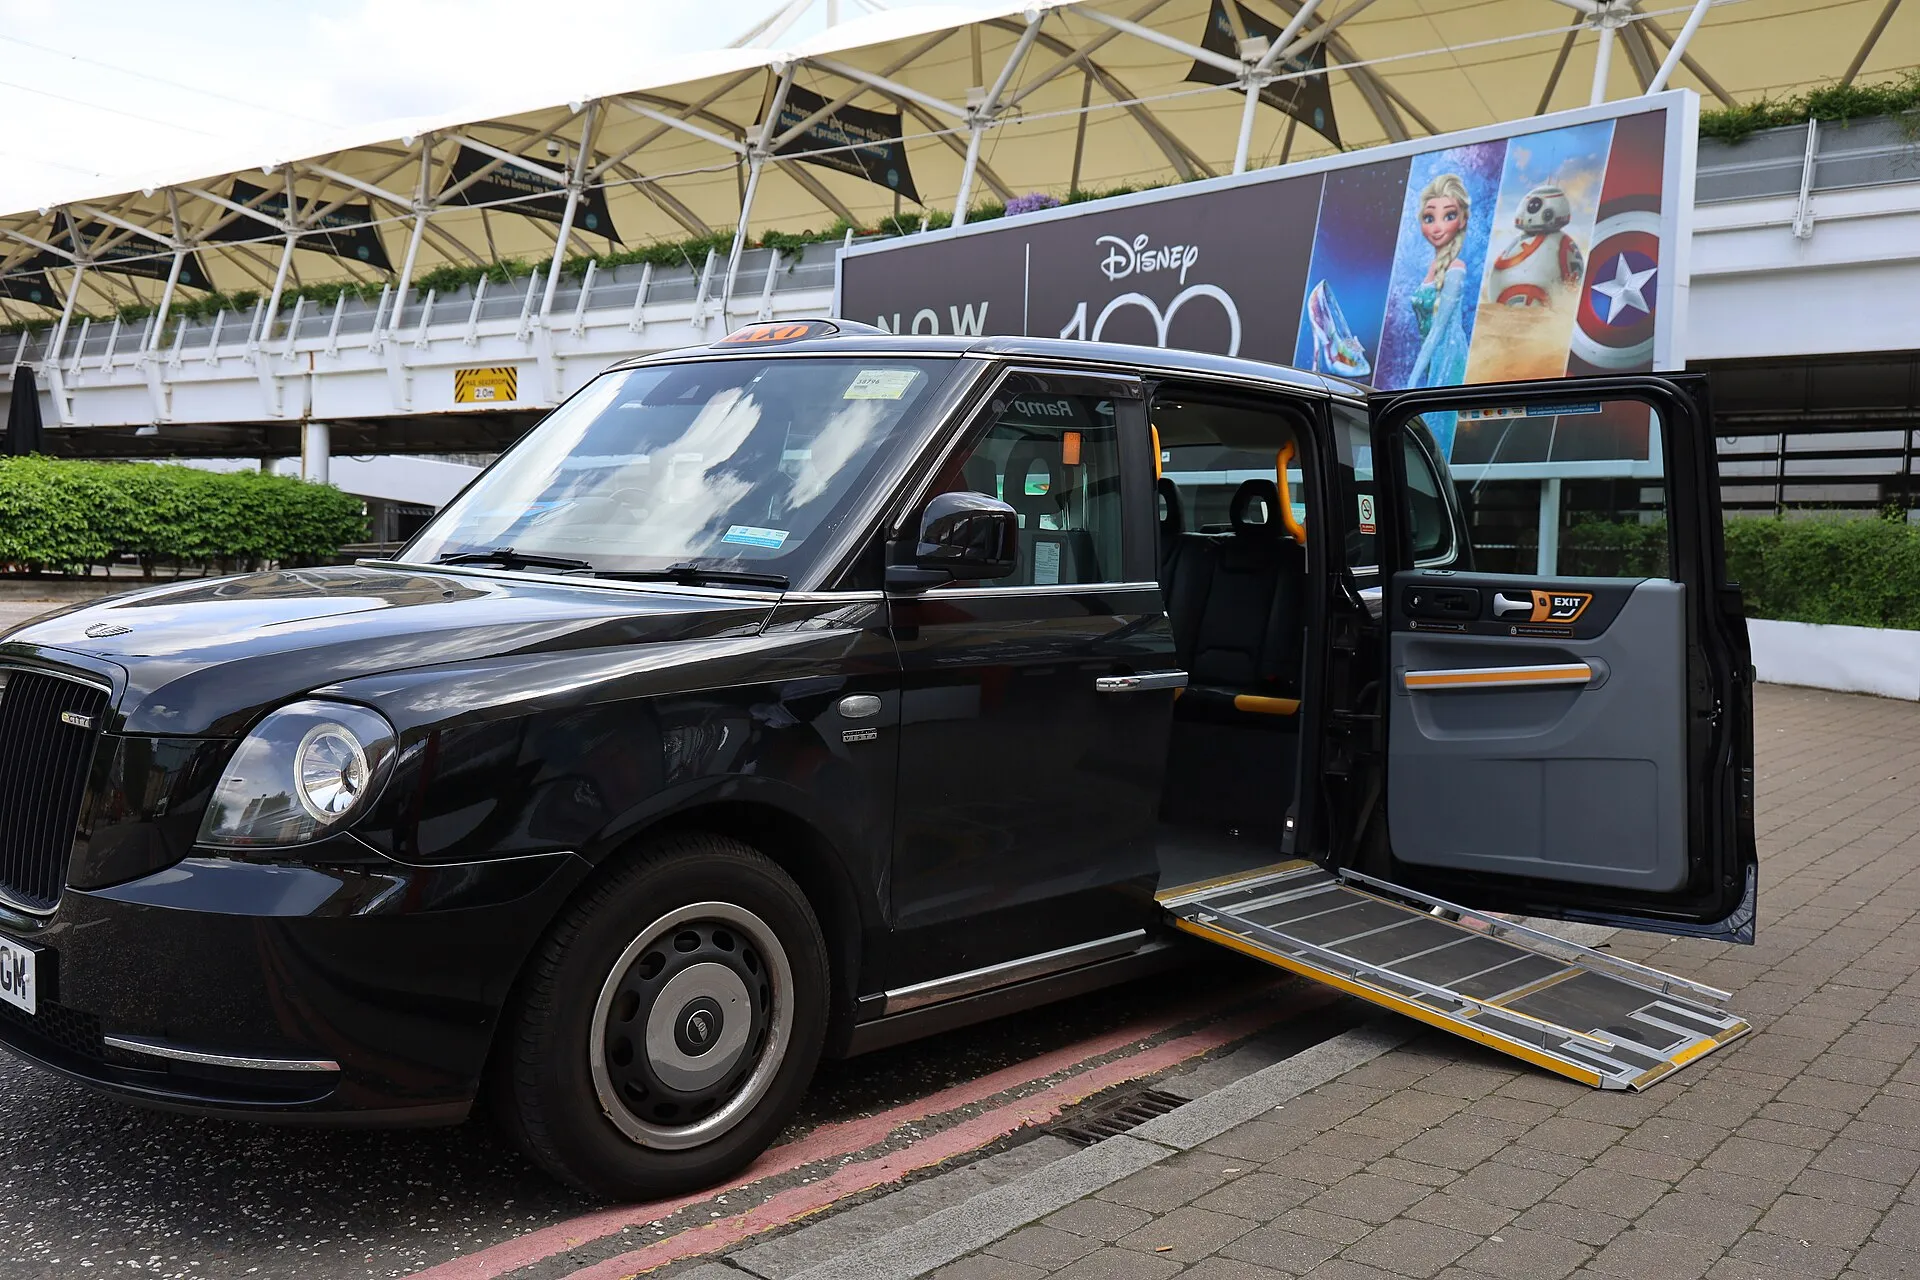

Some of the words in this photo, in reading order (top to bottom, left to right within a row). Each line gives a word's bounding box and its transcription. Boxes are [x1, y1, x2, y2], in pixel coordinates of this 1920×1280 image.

[877, 301, 989, 336] NOW
[475, 388, 494, 398] 2.0m
[1554, 597, 1581, 607] EXIT
